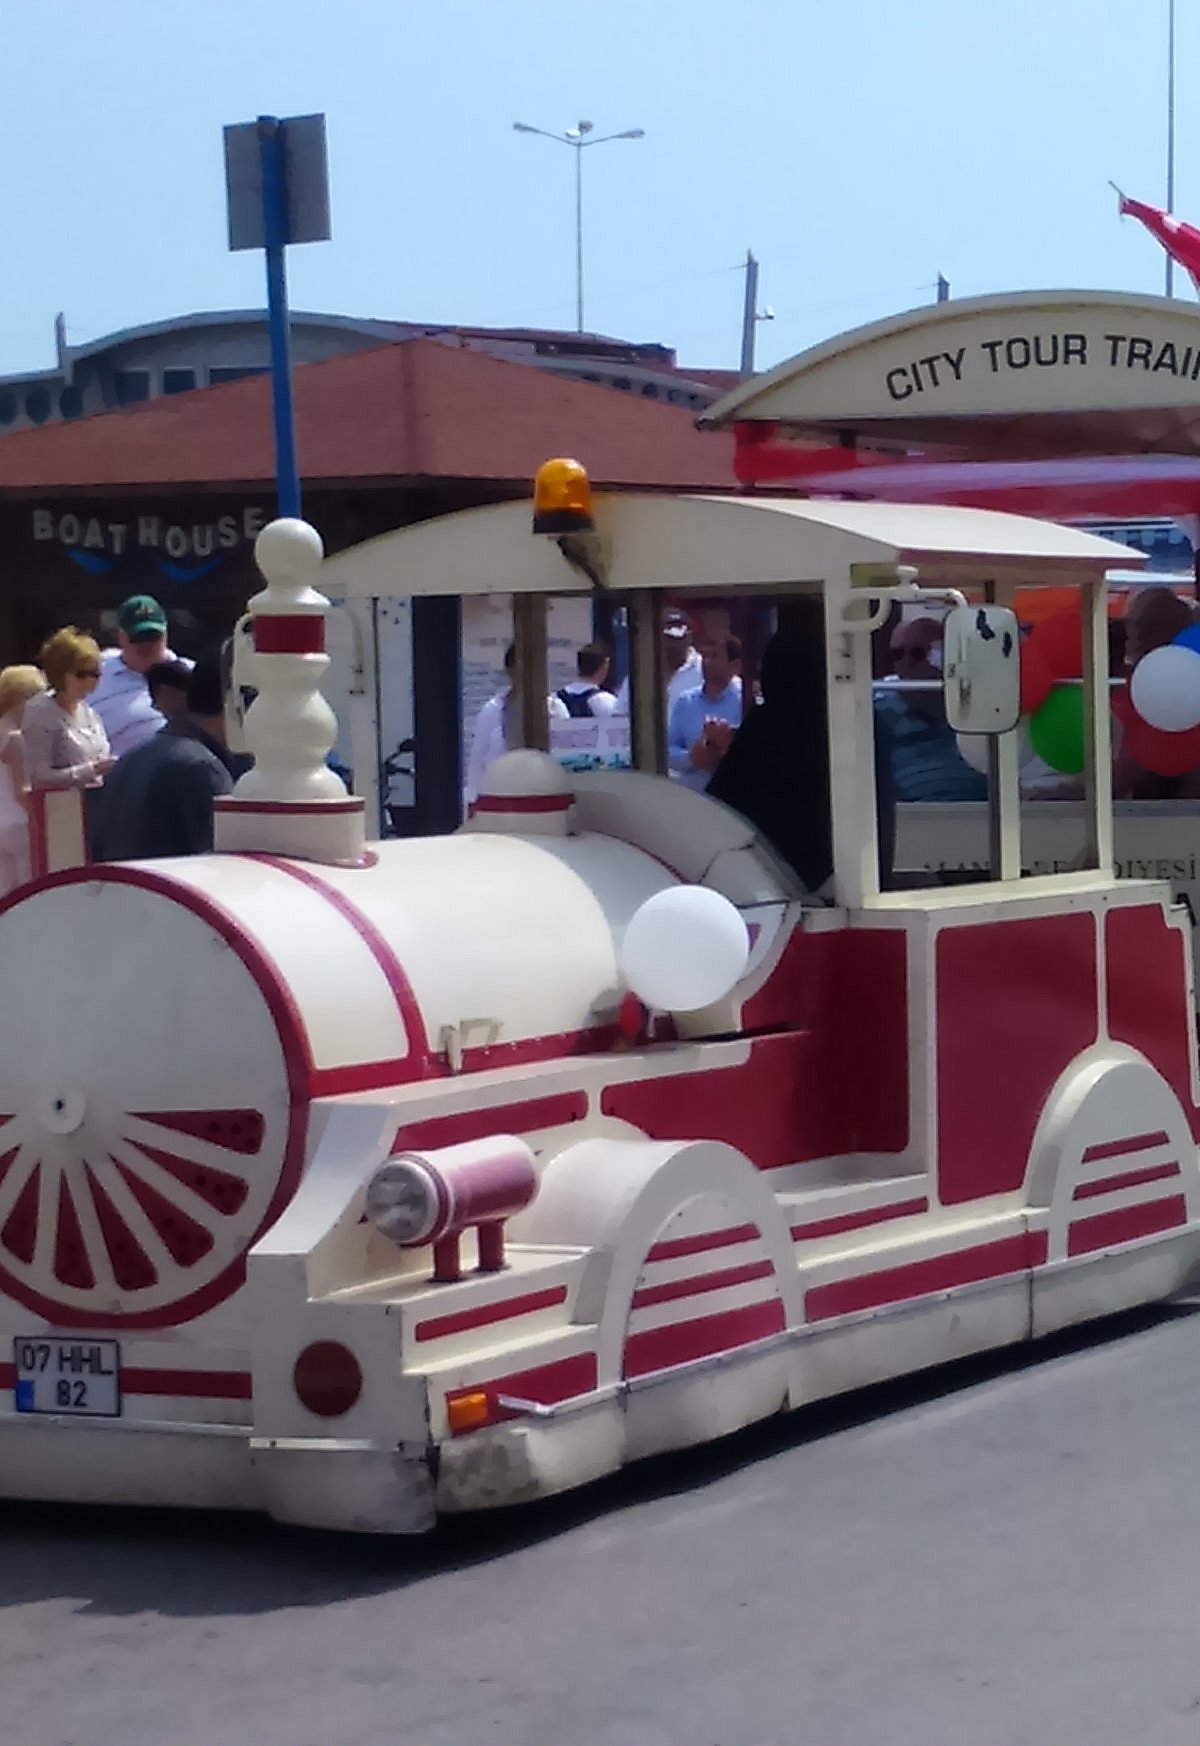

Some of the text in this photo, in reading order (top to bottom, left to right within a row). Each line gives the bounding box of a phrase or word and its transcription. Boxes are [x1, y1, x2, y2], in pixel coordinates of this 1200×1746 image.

[885, 347, 967, 401] CITY
[981, 333, 1088, 372] TOUR
[32, 506, 266, 559] BOAT HOUSE
[23, 1344, 114, 1375] 07 HHL
[57, 1379, 88, 1407] 82
